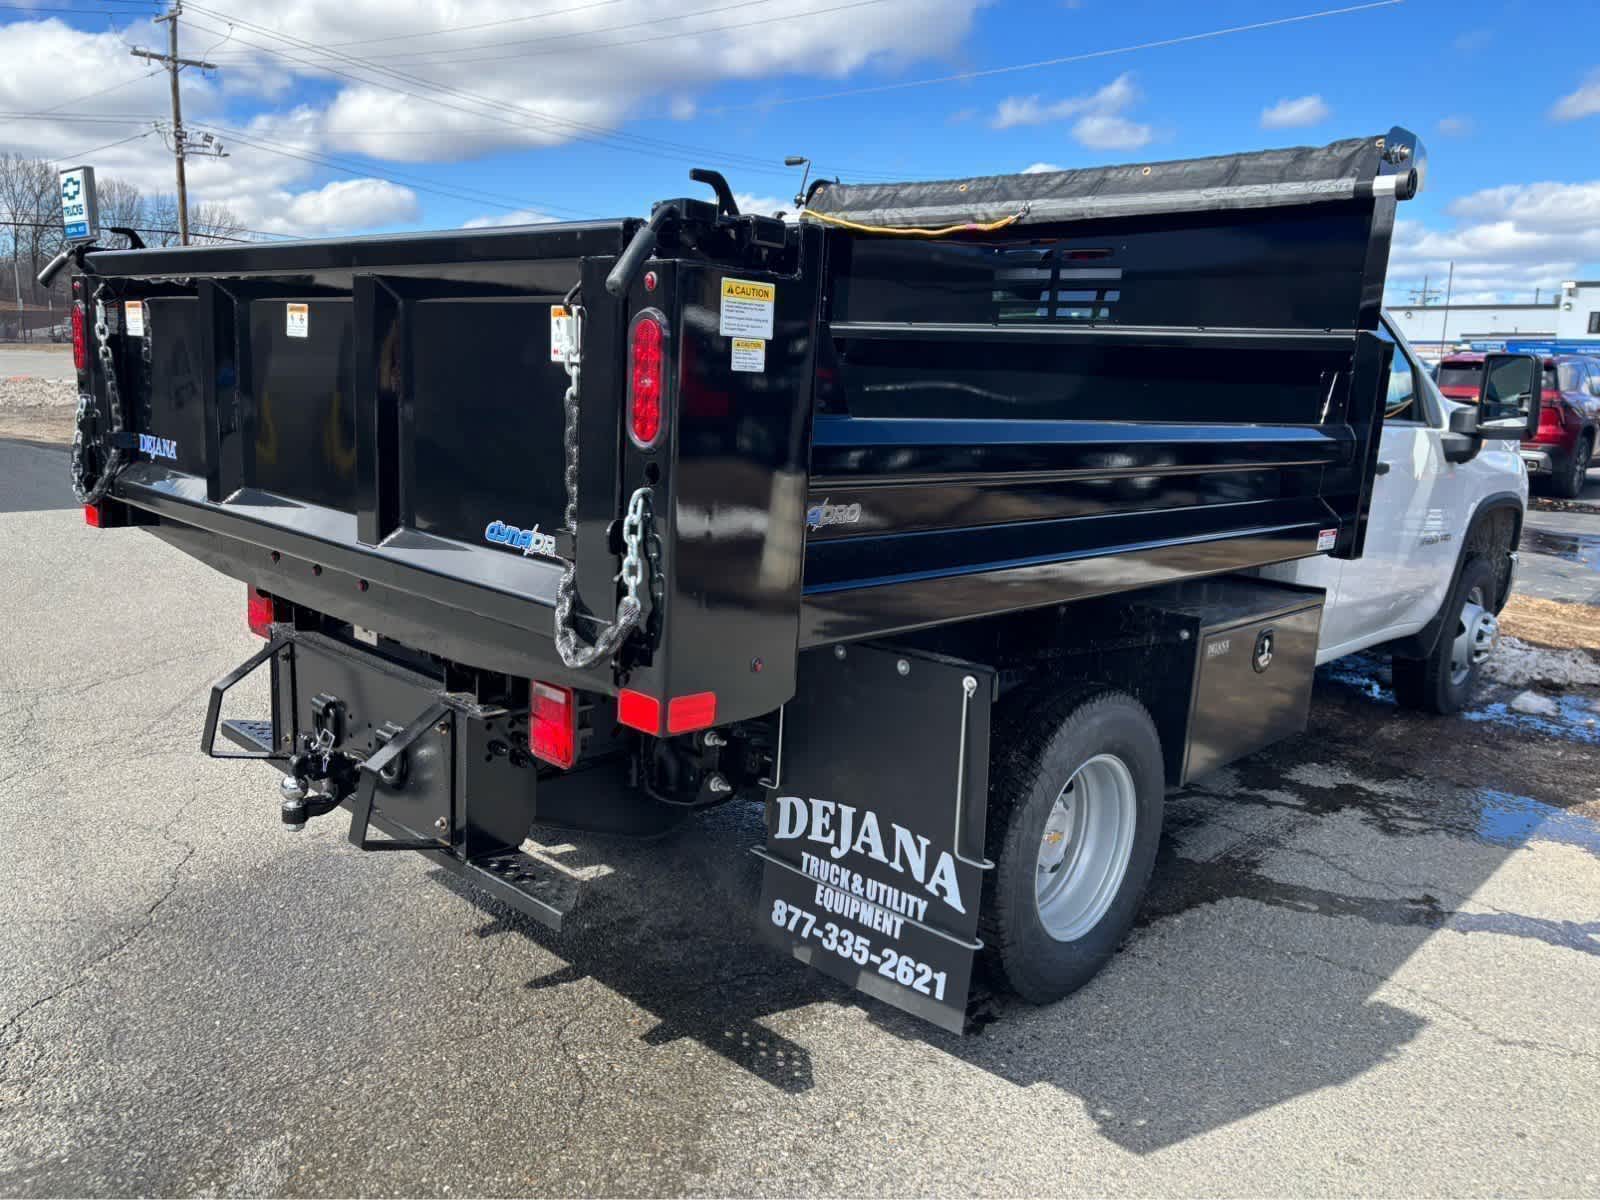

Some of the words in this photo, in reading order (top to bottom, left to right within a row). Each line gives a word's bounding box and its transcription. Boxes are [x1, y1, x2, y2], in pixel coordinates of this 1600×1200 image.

[734, 285, 770, 299] CAUTION
[139, 433, 177, 460] DEJANA
[773, 796, 967, 915] DEJANA
[815, 884, 905, 940] EQUIPMENT
[771, 899, 948, 1001] 877-335-2621
